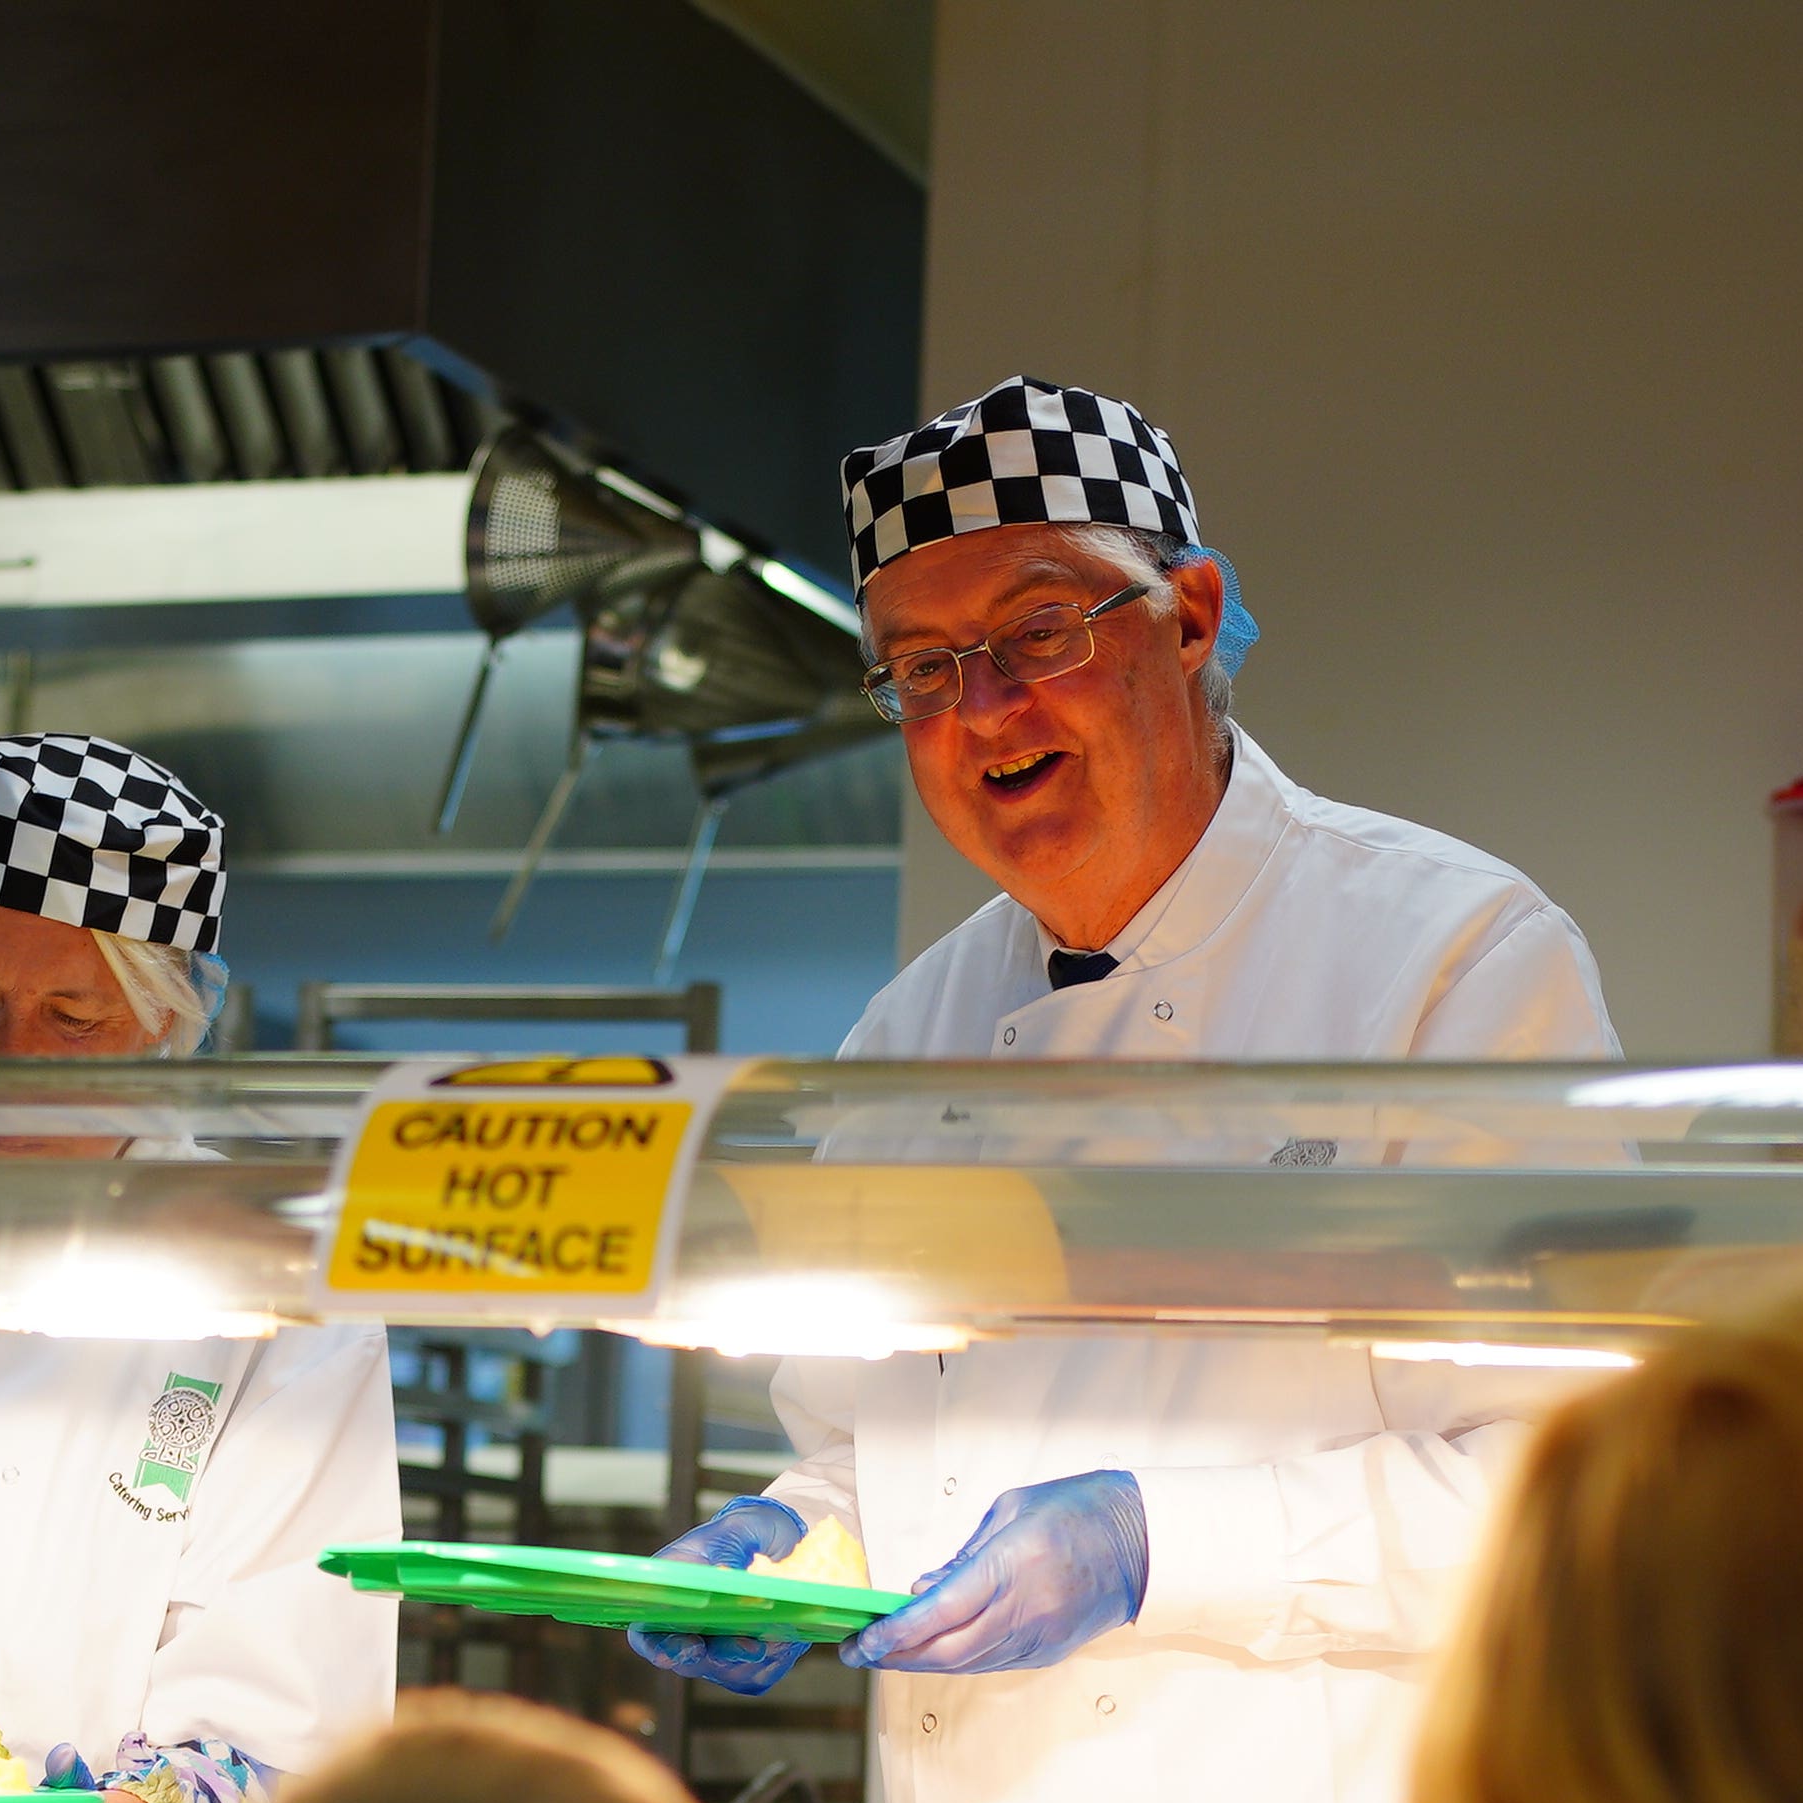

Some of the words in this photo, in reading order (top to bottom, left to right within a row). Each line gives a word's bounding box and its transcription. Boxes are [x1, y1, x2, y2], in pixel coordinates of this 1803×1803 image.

[393, 1109, 660, 1151] CAUTION
[441, 1163, 570, 1211] HOT
[353, 1222, 636, 1278] SURFACE
[108, 1472, 152, 1521] Catering
[156, 1505, 191, 1522] Serv
